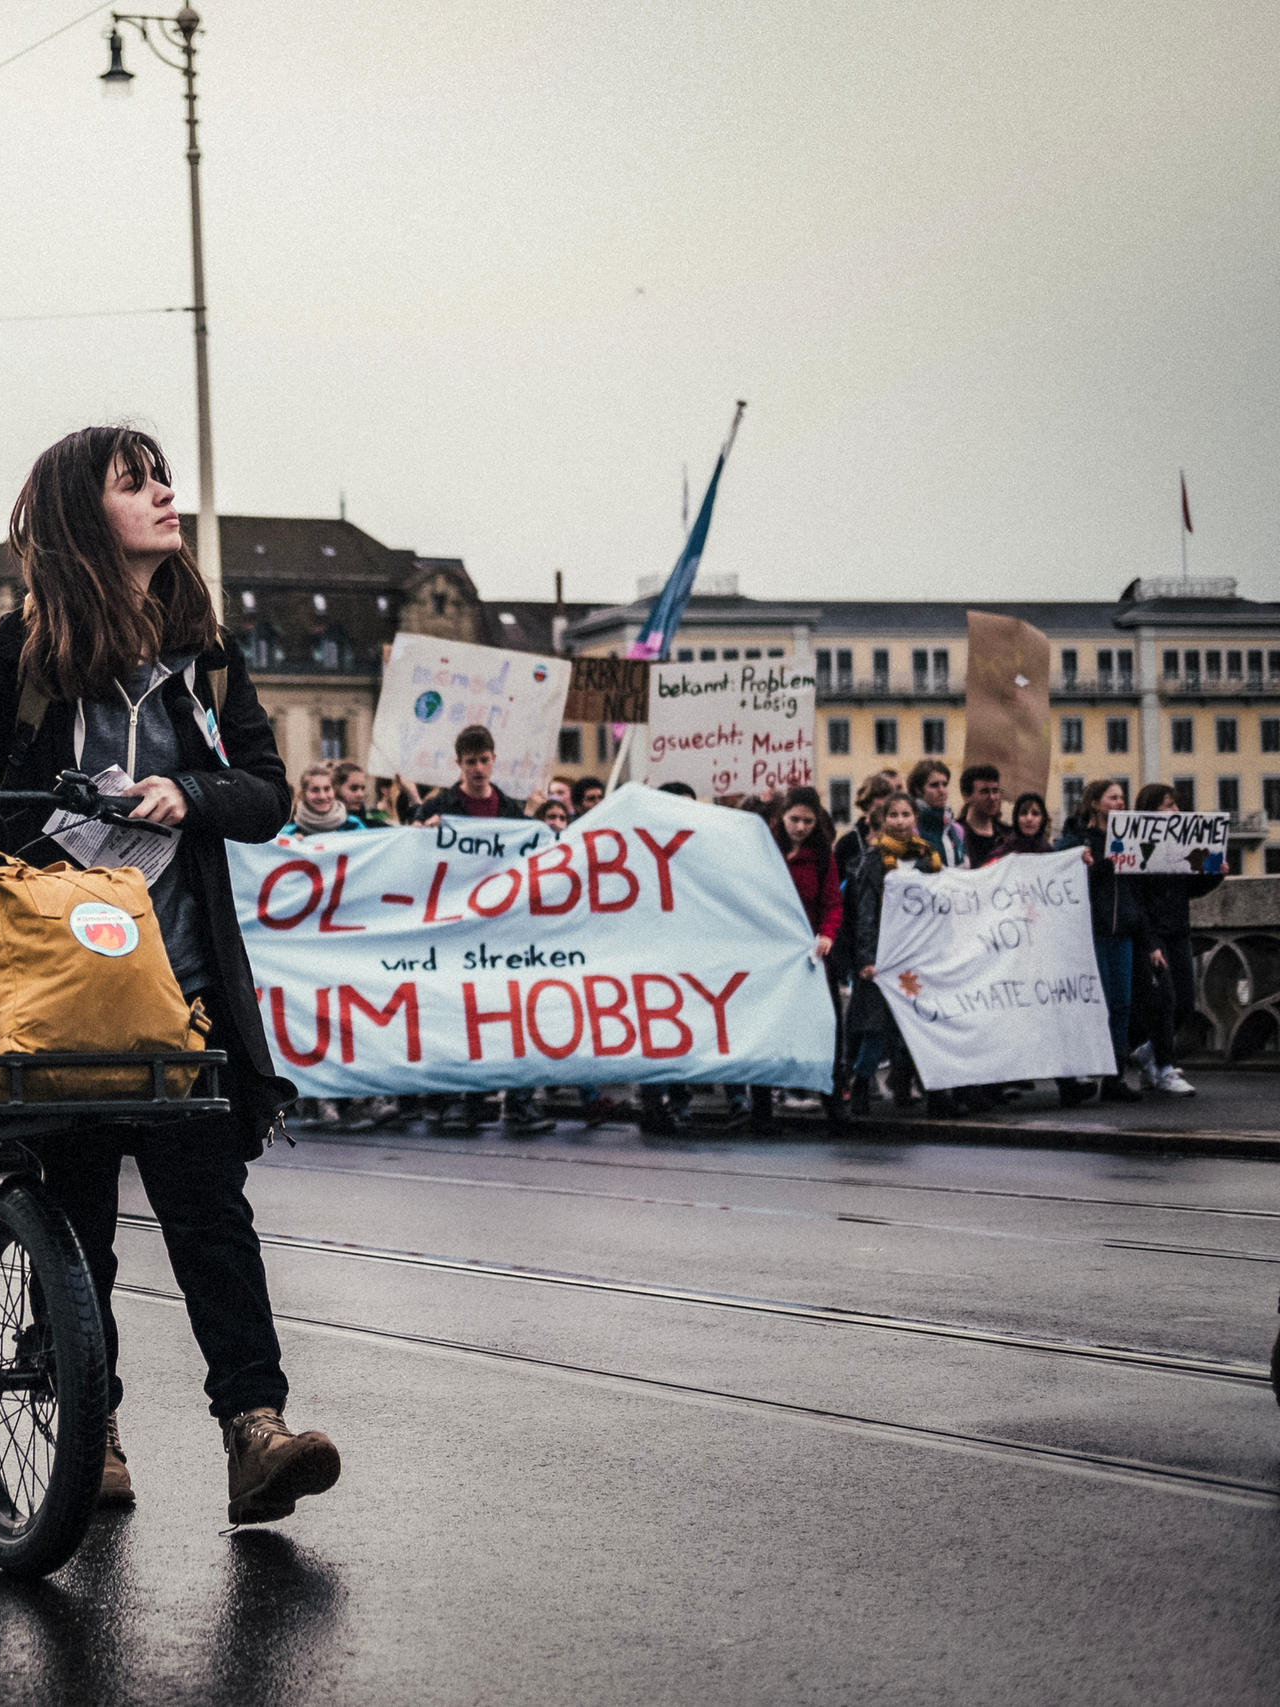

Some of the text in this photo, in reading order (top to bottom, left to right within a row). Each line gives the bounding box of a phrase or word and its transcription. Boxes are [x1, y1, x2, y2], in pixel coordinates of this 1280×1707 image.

[741, 664, 816, 697] Problem
[436, 822, 505, 857] Dank
[990, 877, 1080, 911] CHANGE
[978, 917, 1034, 955] NOT
[381, 943, 586, 971] wird streiken
[913, 973, 1101, 1023] CLIMATE CHANGE
[257, 971, 750, 1067] UM HOBBY
